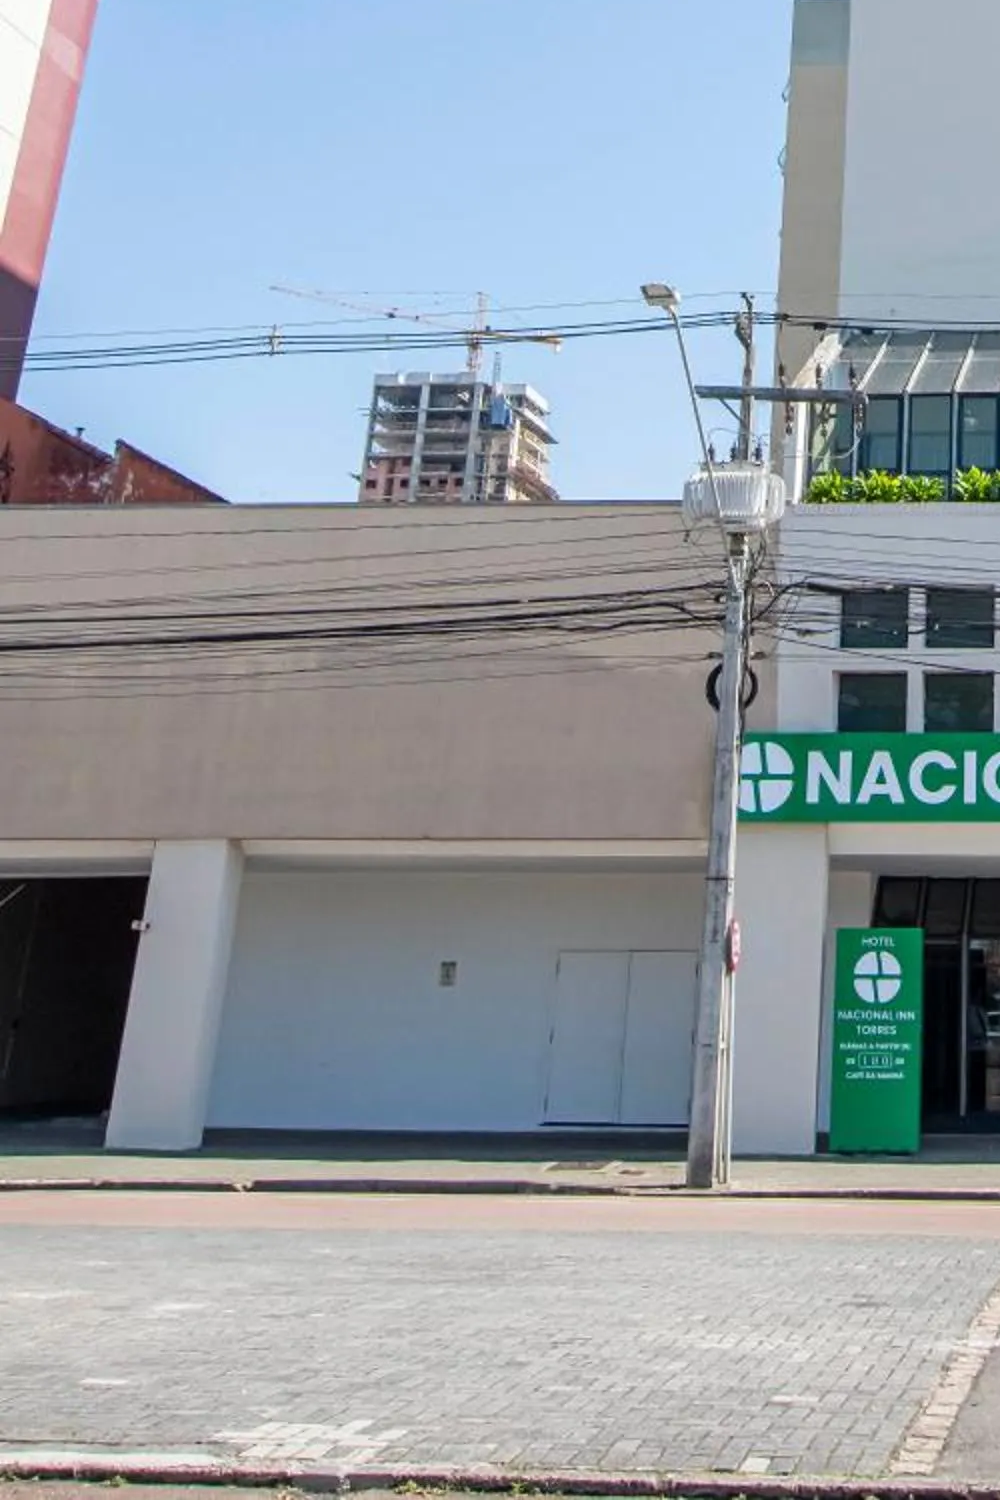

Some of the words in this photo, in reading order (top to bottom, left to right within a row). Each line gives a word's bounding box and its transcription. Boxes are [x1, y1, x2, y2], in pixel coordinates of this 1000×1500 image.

[862, 936, 895, 947] HOTEL
[837, 1009, 893, 1021] NACIONAL
[895, 1010, 916, 1020] INN
[856, 1025, 897, 1035] TORRES
